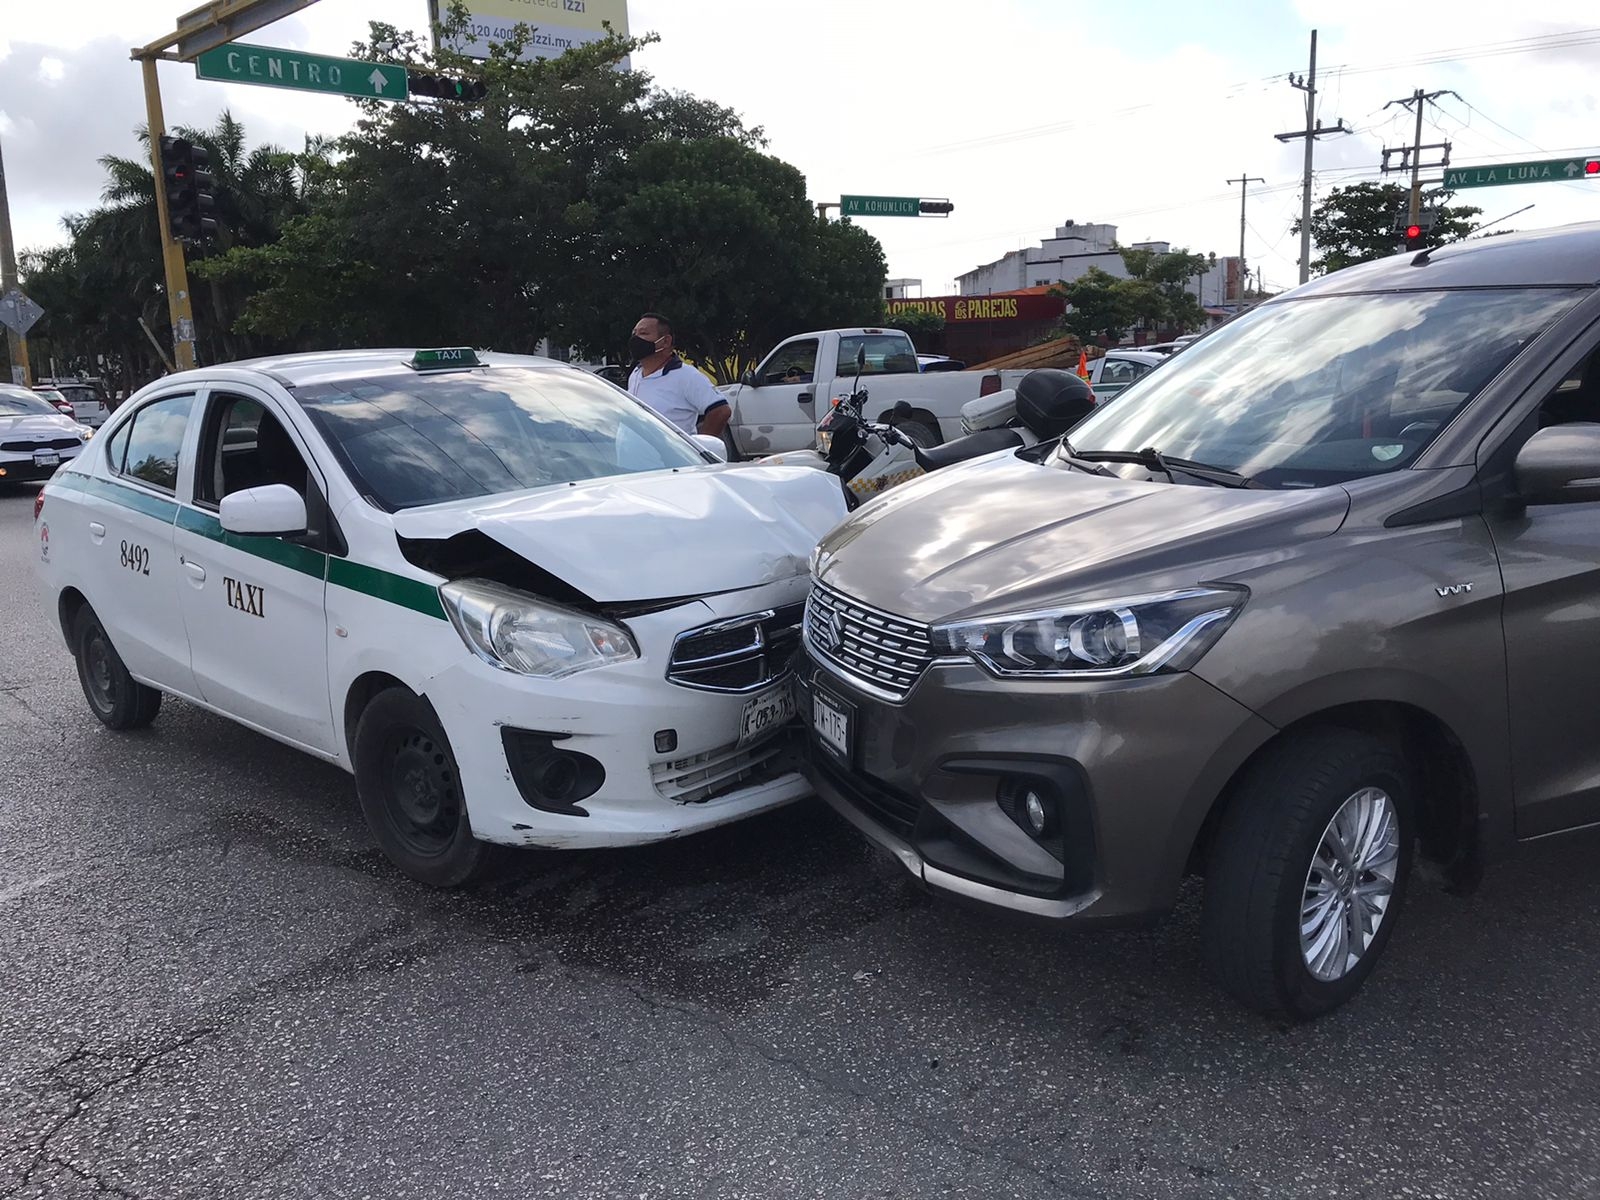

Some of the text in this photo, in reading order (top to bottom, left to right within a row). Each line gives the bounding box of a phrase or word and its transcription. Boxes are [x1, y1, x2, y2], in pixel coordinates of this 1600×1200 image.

[563, 0, 586, 13] izzi
[471, 24, 490, 37] 120
[227, 52, 342, 85] CENTRO
[1448, 166, 1551, 185] AV. LA LUNA
[865, 200, 914, 212] KOHUNLICH
[968, 299, 1018, 319] PAREJAS
[435, 350, 462, 360] TAXI
[120, 540, 150, 576] 8492
[223, 576, 265, 618] TAXI
